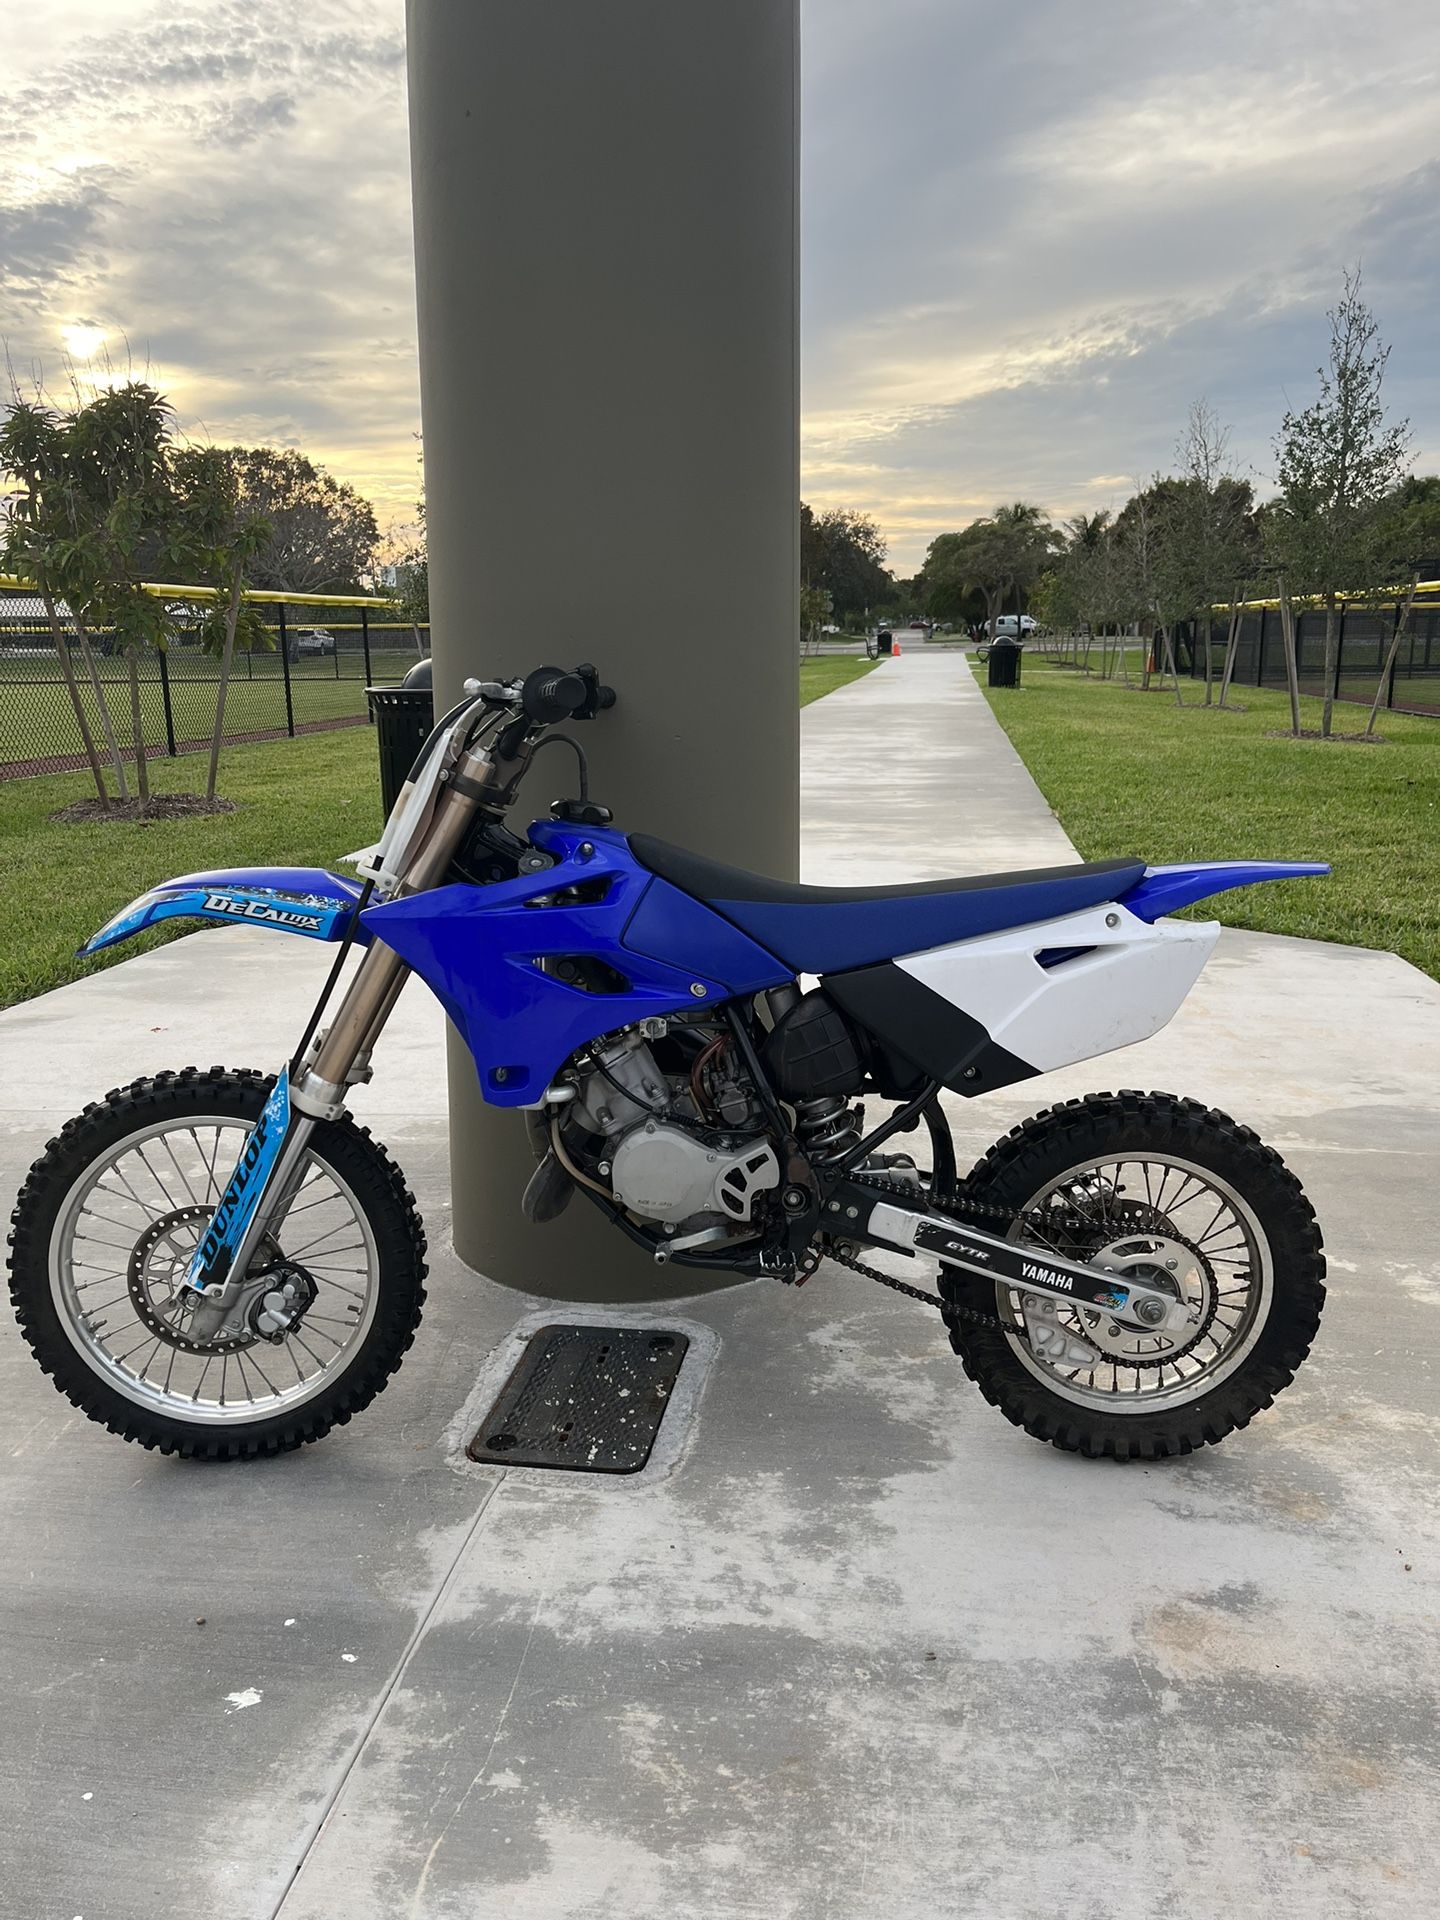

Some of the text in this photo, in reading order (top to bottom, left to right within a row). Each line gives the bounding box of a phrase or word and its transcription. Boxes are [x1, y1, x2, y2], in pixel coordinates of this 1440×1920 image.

[200, 1115, 269, 1269] DUNLOP
[945, 1241, 990, 1261] GYTR
[1021, 1262, 1074, 1290] YAMAHA
